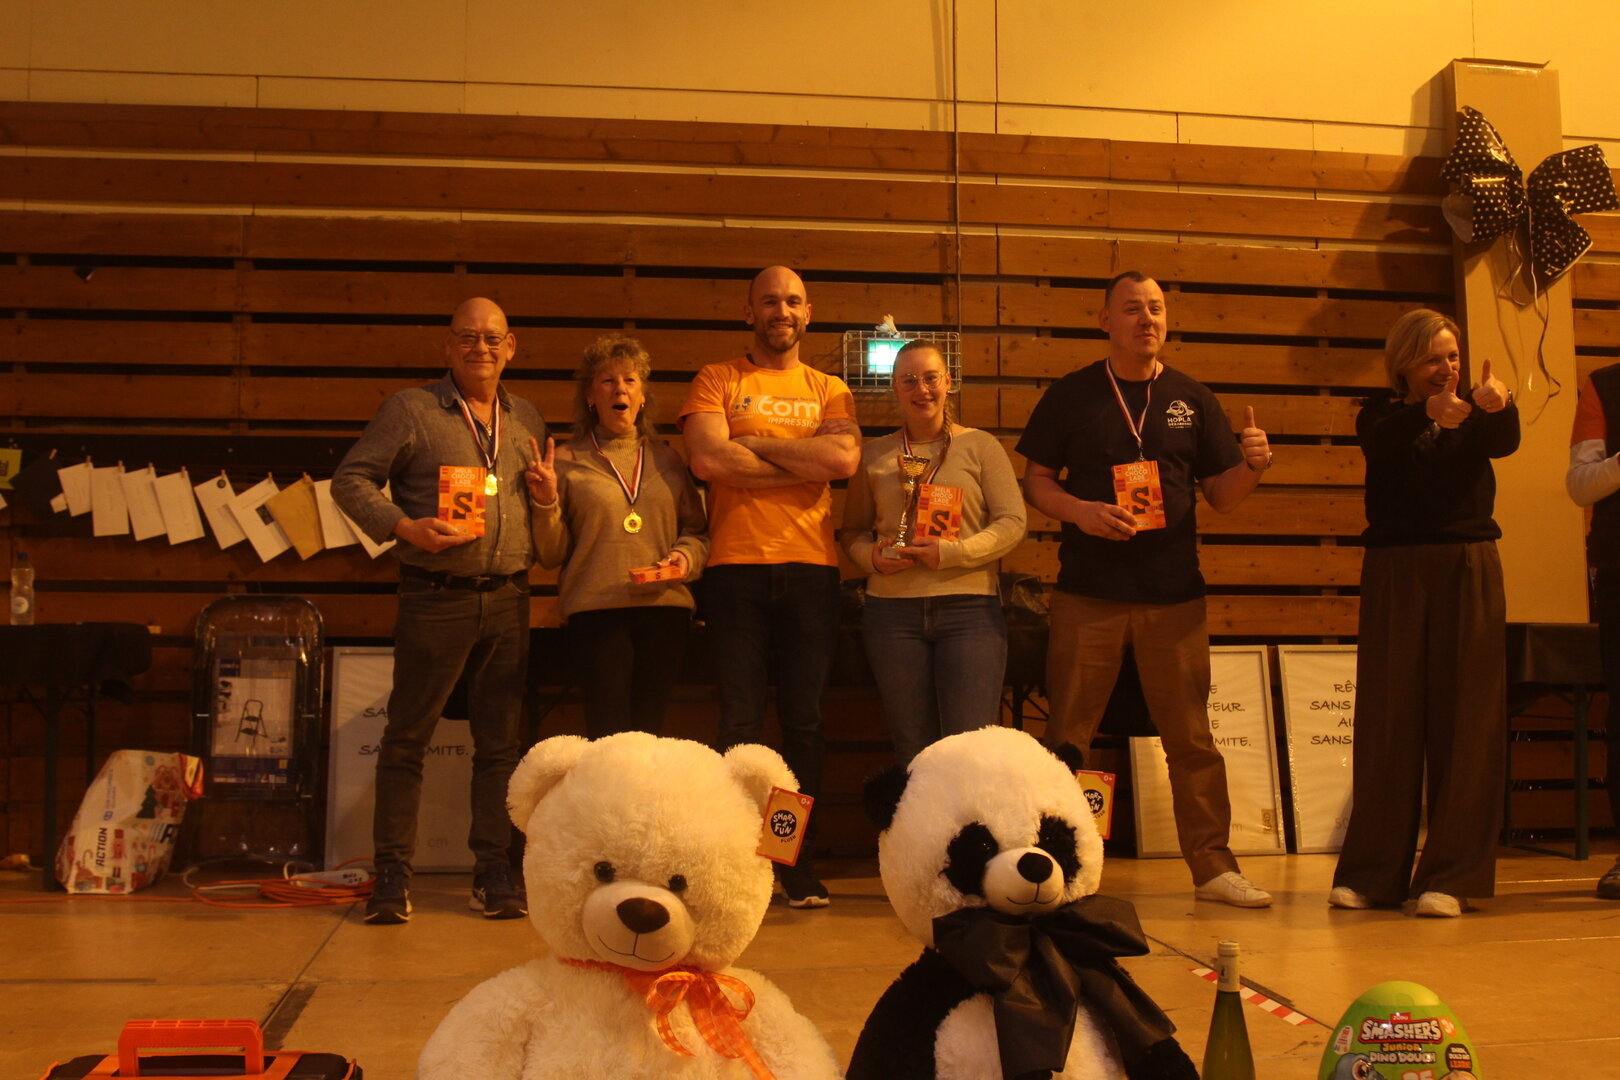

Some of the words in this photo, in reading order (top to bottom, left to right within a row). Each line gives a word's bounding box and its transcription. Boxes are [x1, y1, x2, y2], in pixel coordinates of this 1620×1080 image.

[1125, 469, 1148, 477] CHOCO
[452, 492, 472, 519] S
[1131, 486, 1150, 514] S
[929, 511, 949, 536] S
[1309, 700, 1351, 710] SANS
[362, 707, 388, 718] SA
[1214, 736, 1251, 747] MITE.
[1310, 735, 1353, 745] SANS
[358, 745, 382, 756] SA
[426, 745, 469, 756] MITE.
[773, 812, 796, 824] SMART
[774, 823, 792, 835] FUN
[95, 827, 107, 867] ACTION
[1361, 1019, 1442, 1041] SMASHERS
[1369, 1052, 1397, 1063] DINO
